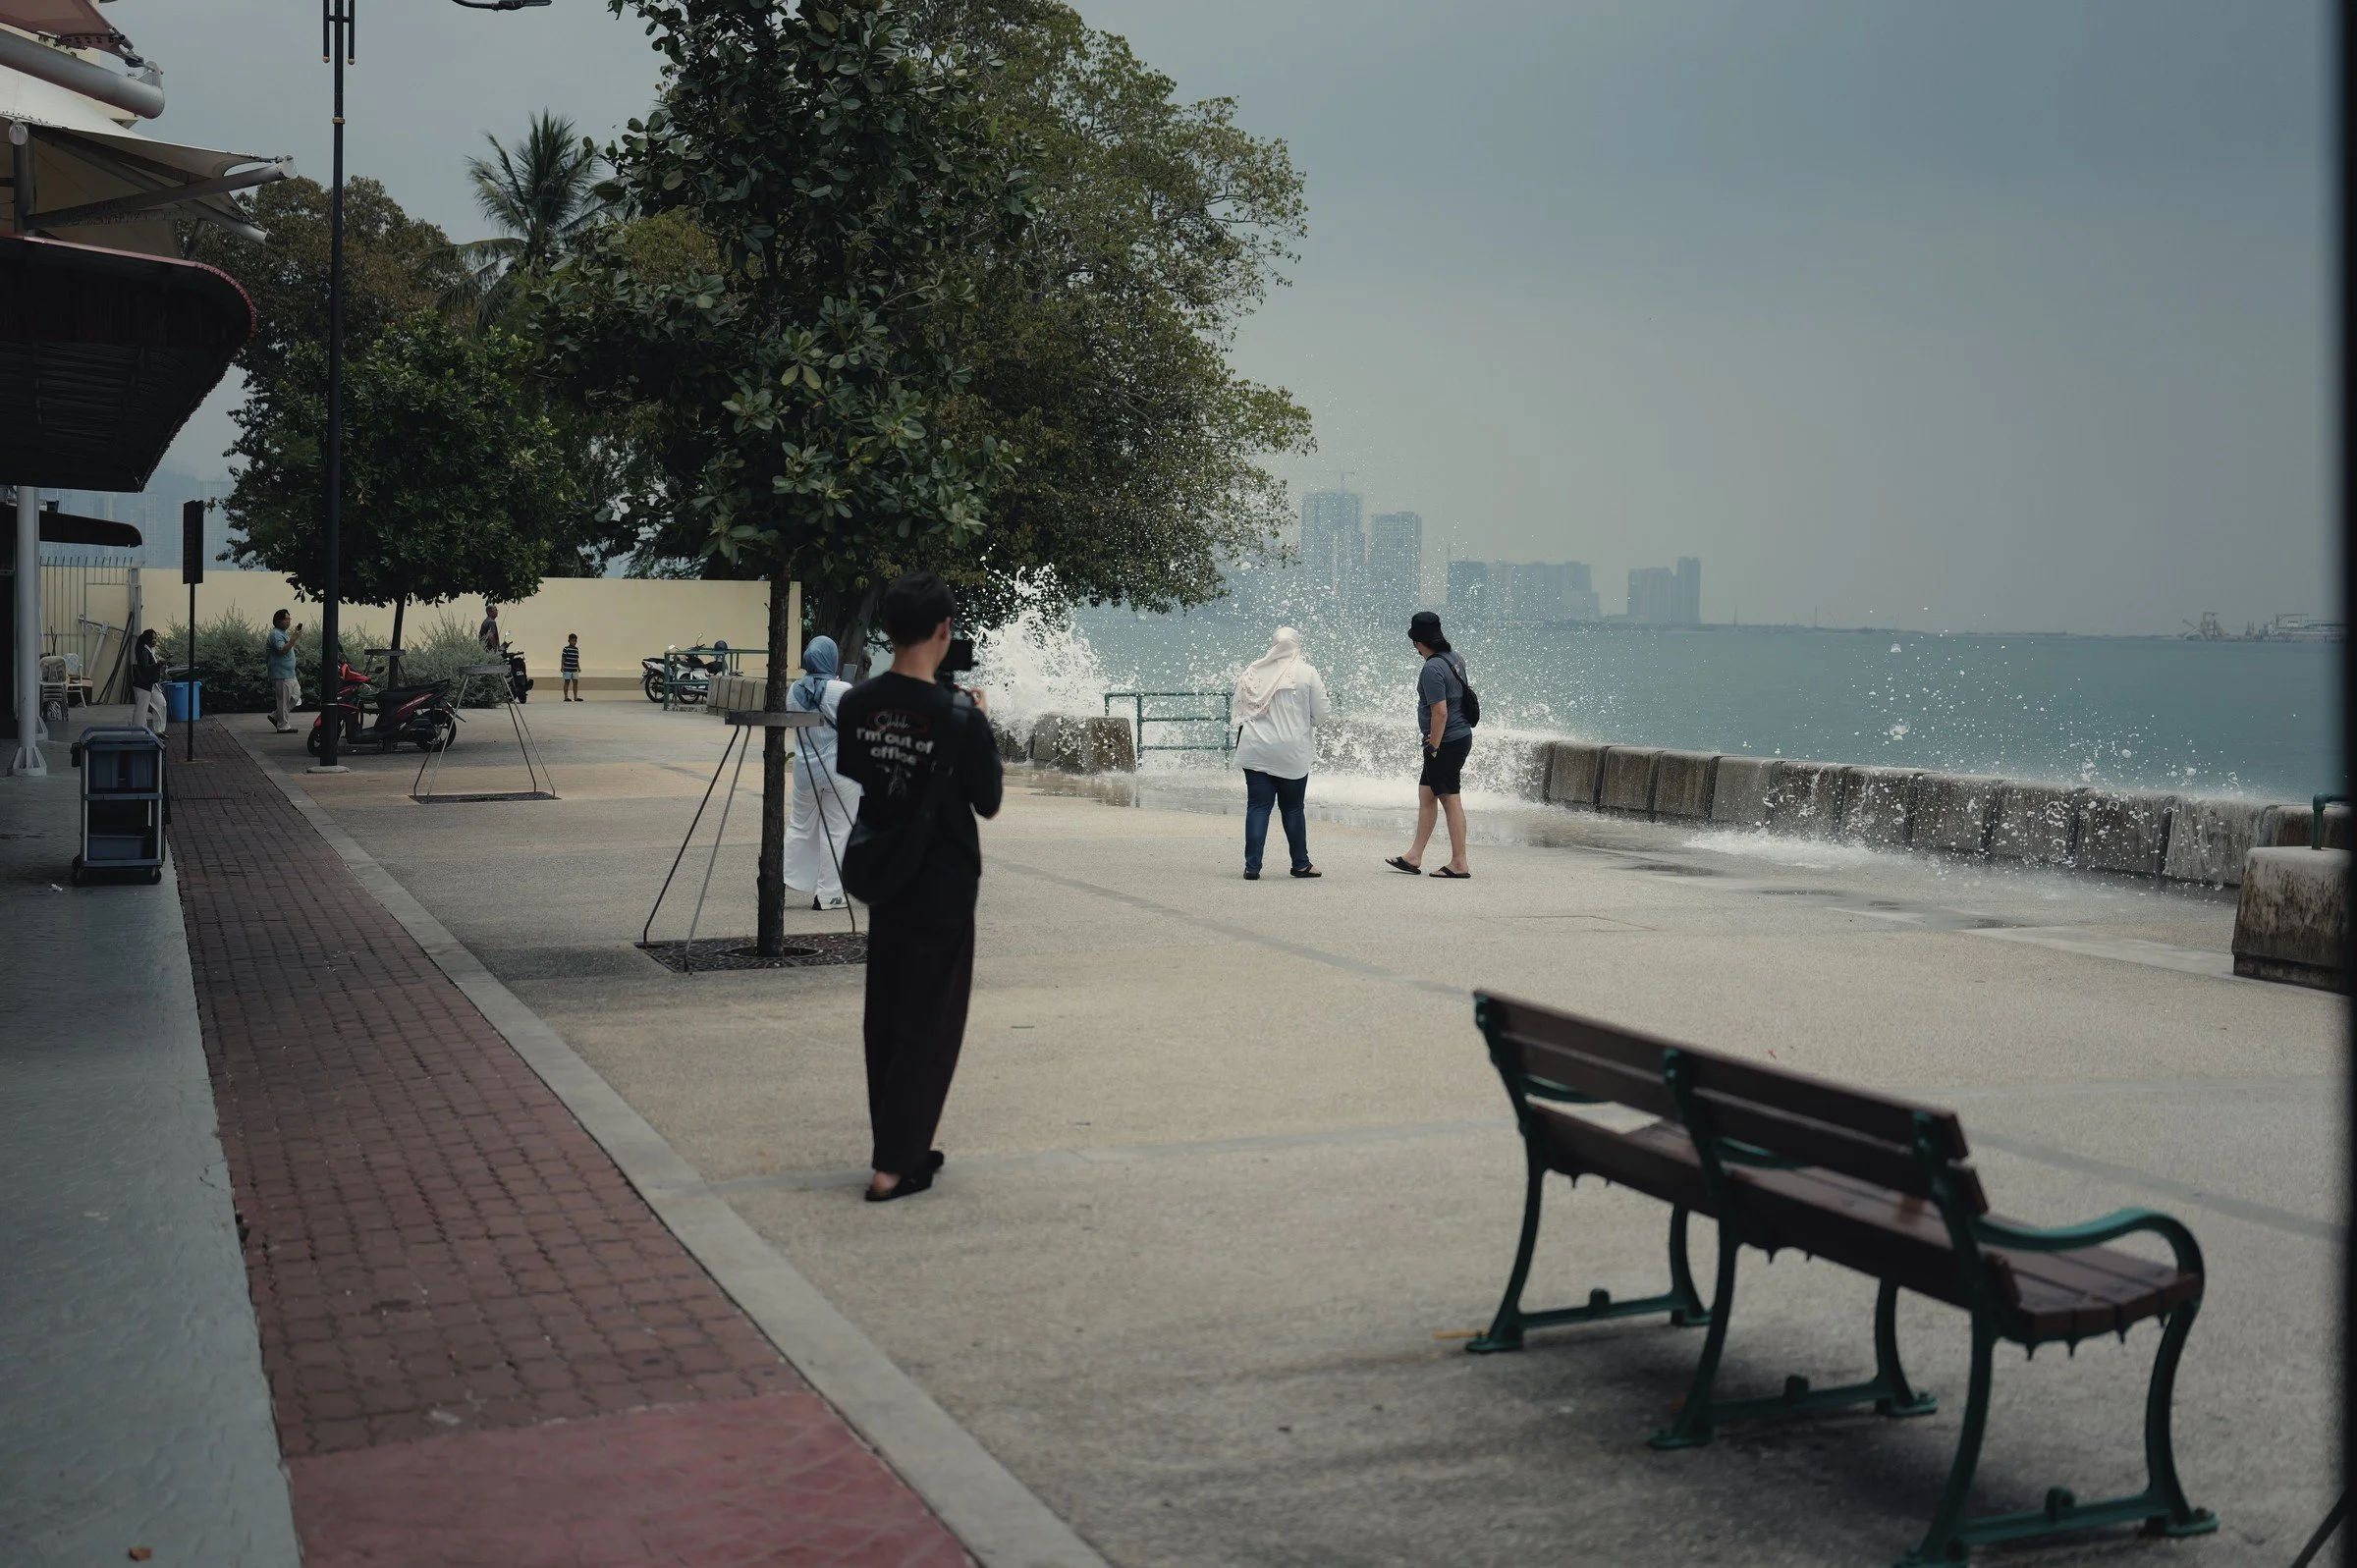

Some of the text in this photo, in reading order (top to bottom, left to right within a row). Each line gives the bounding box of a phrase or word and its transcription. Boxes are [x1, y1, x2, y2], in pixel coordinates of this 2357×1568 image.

[856, 728, 935, 754] I'm out of
[869, 746, 917, 766] office
